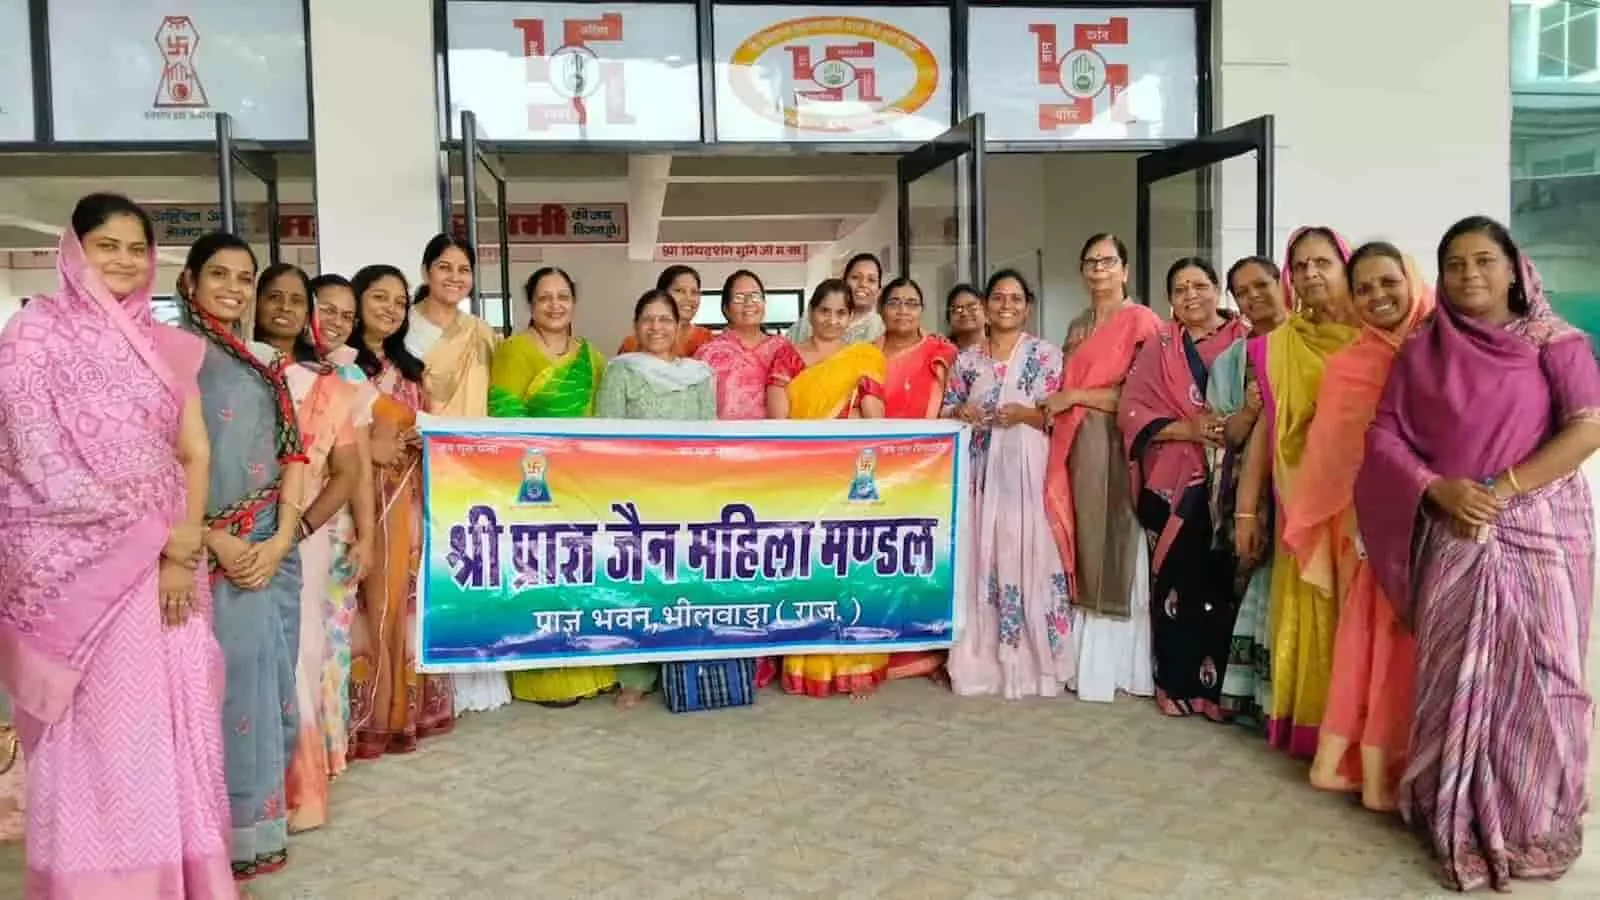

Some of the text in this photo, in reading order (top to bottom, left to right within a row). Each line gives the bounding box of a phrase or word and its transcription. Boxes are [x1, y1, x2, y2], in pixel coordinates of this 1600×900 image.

[446, 503, 504, 590] श्री
[605, 502, 681, 583] जैन
[687, 503, 815, 580] महिला
[819, 517, 939, 577] मण्डल
[532, 609, 584, 636] प्राज्ञ
[661, 597, 771, 630] भीलवाड़ा
